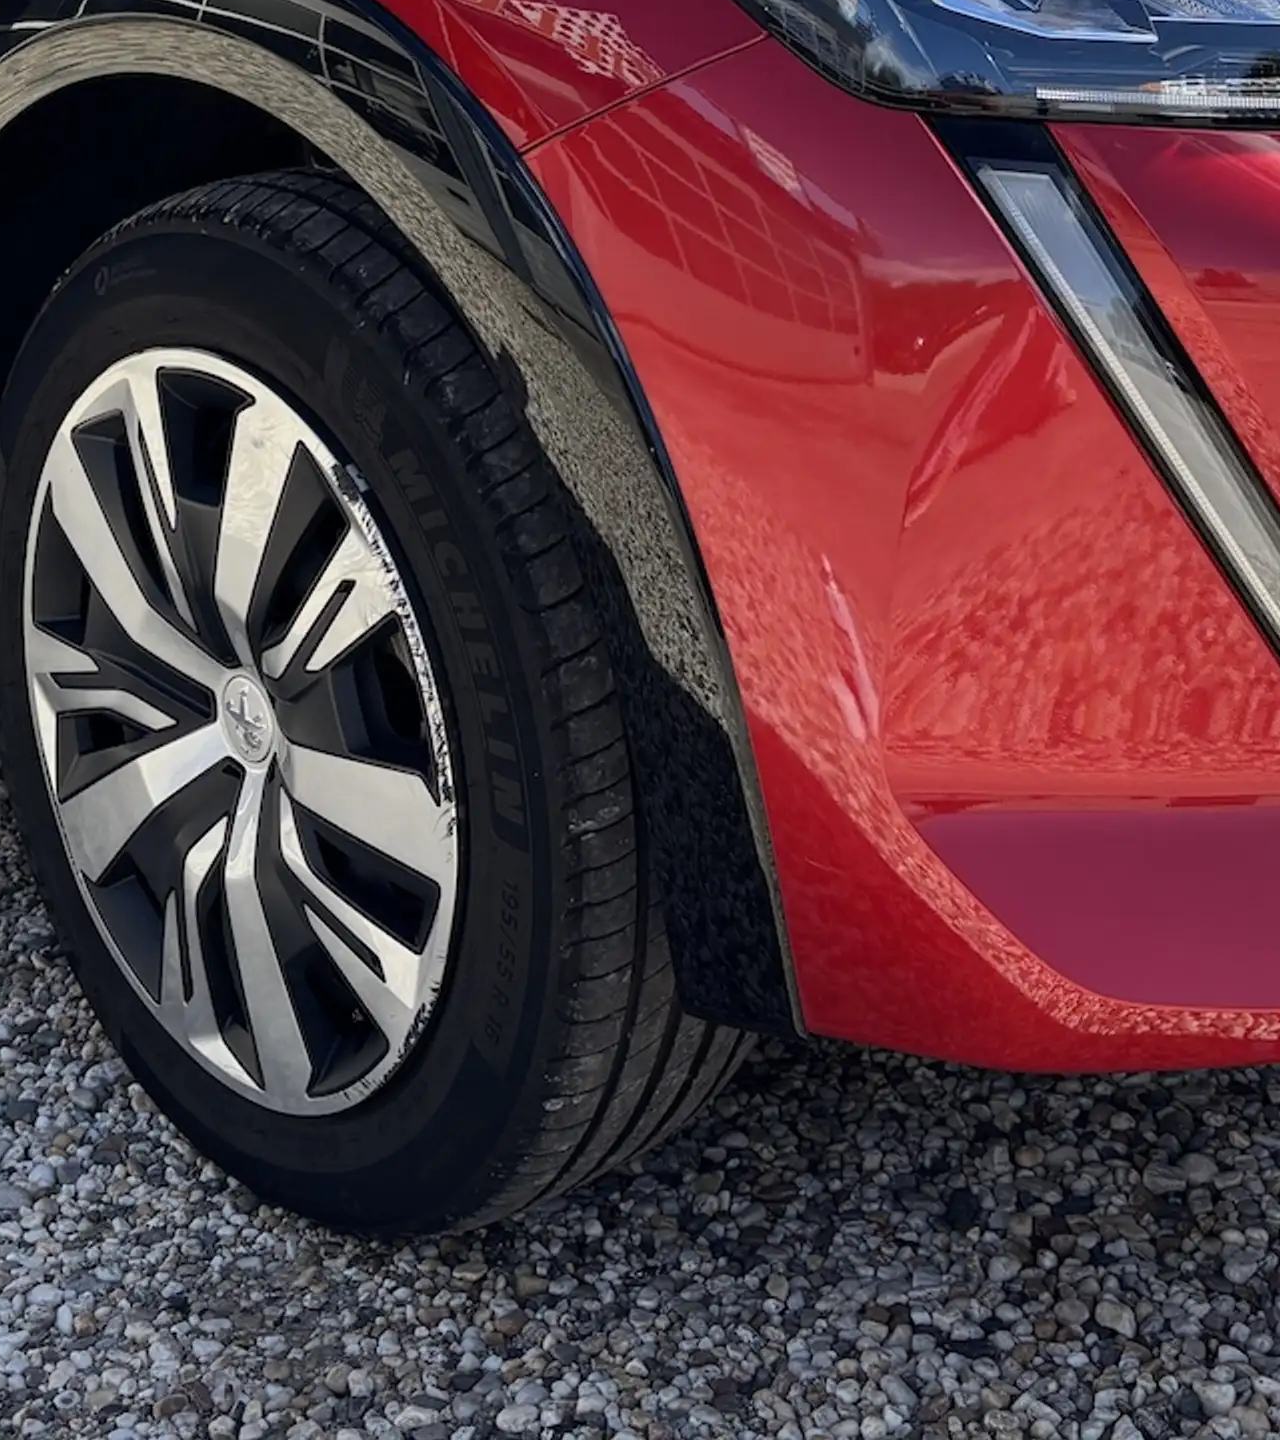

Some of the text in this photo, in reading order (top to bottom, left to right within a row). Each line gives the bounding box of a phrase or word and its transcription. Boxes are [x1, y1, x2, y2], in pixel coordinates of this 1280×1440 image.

[387, 447, 525, 826] MICHELIN
[483, 877, 520, 1048] 195/55 R 16
